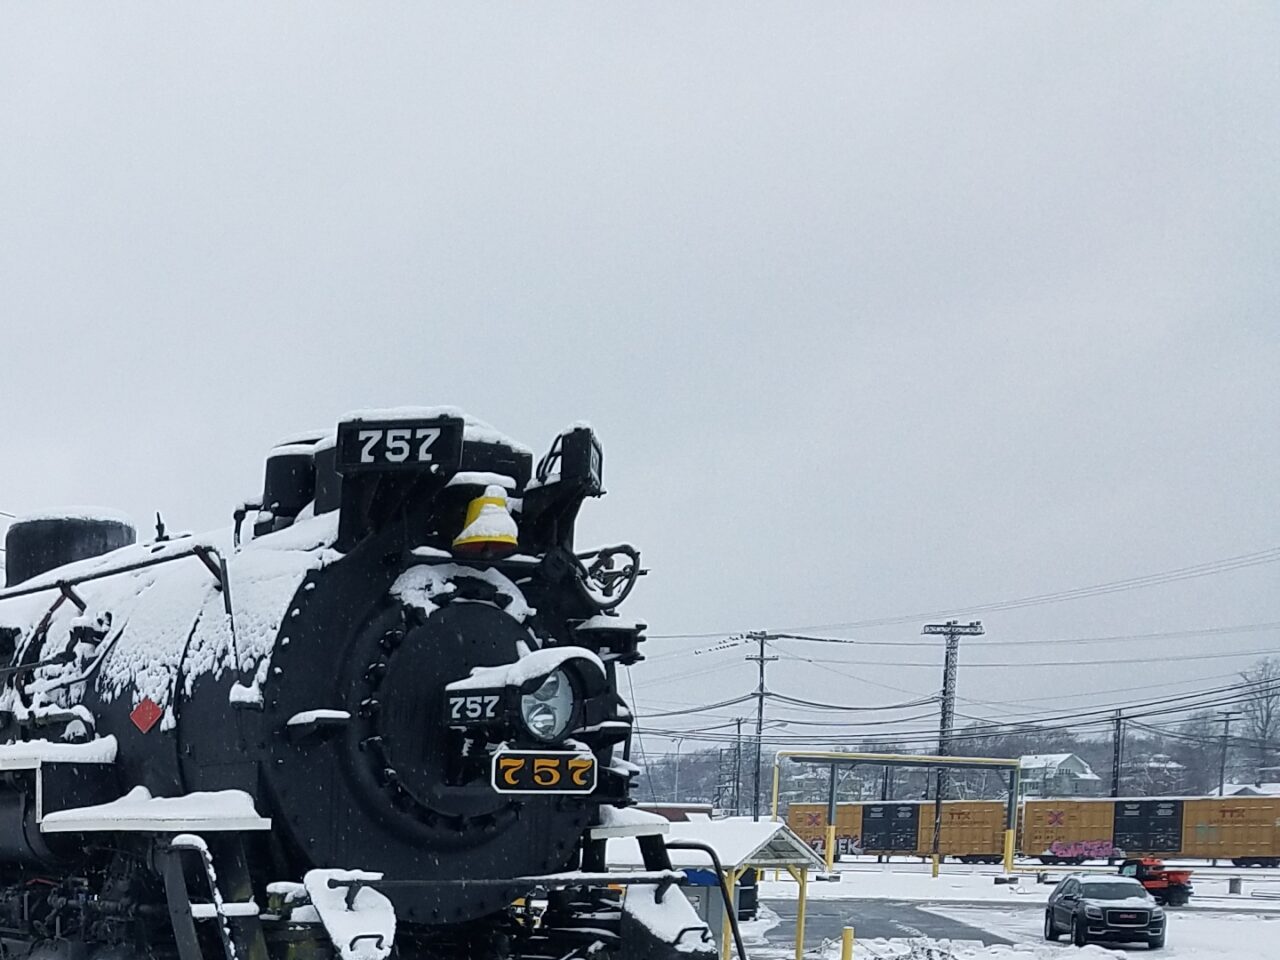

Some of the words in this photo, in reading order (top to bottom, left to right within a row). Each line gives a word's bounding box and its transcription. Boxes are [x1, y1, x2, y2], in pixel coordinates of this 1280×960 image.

[358, 427, 441, 463] 757
[449, 696, 500, 719] 757
[499, 757, 593, 786] 757
